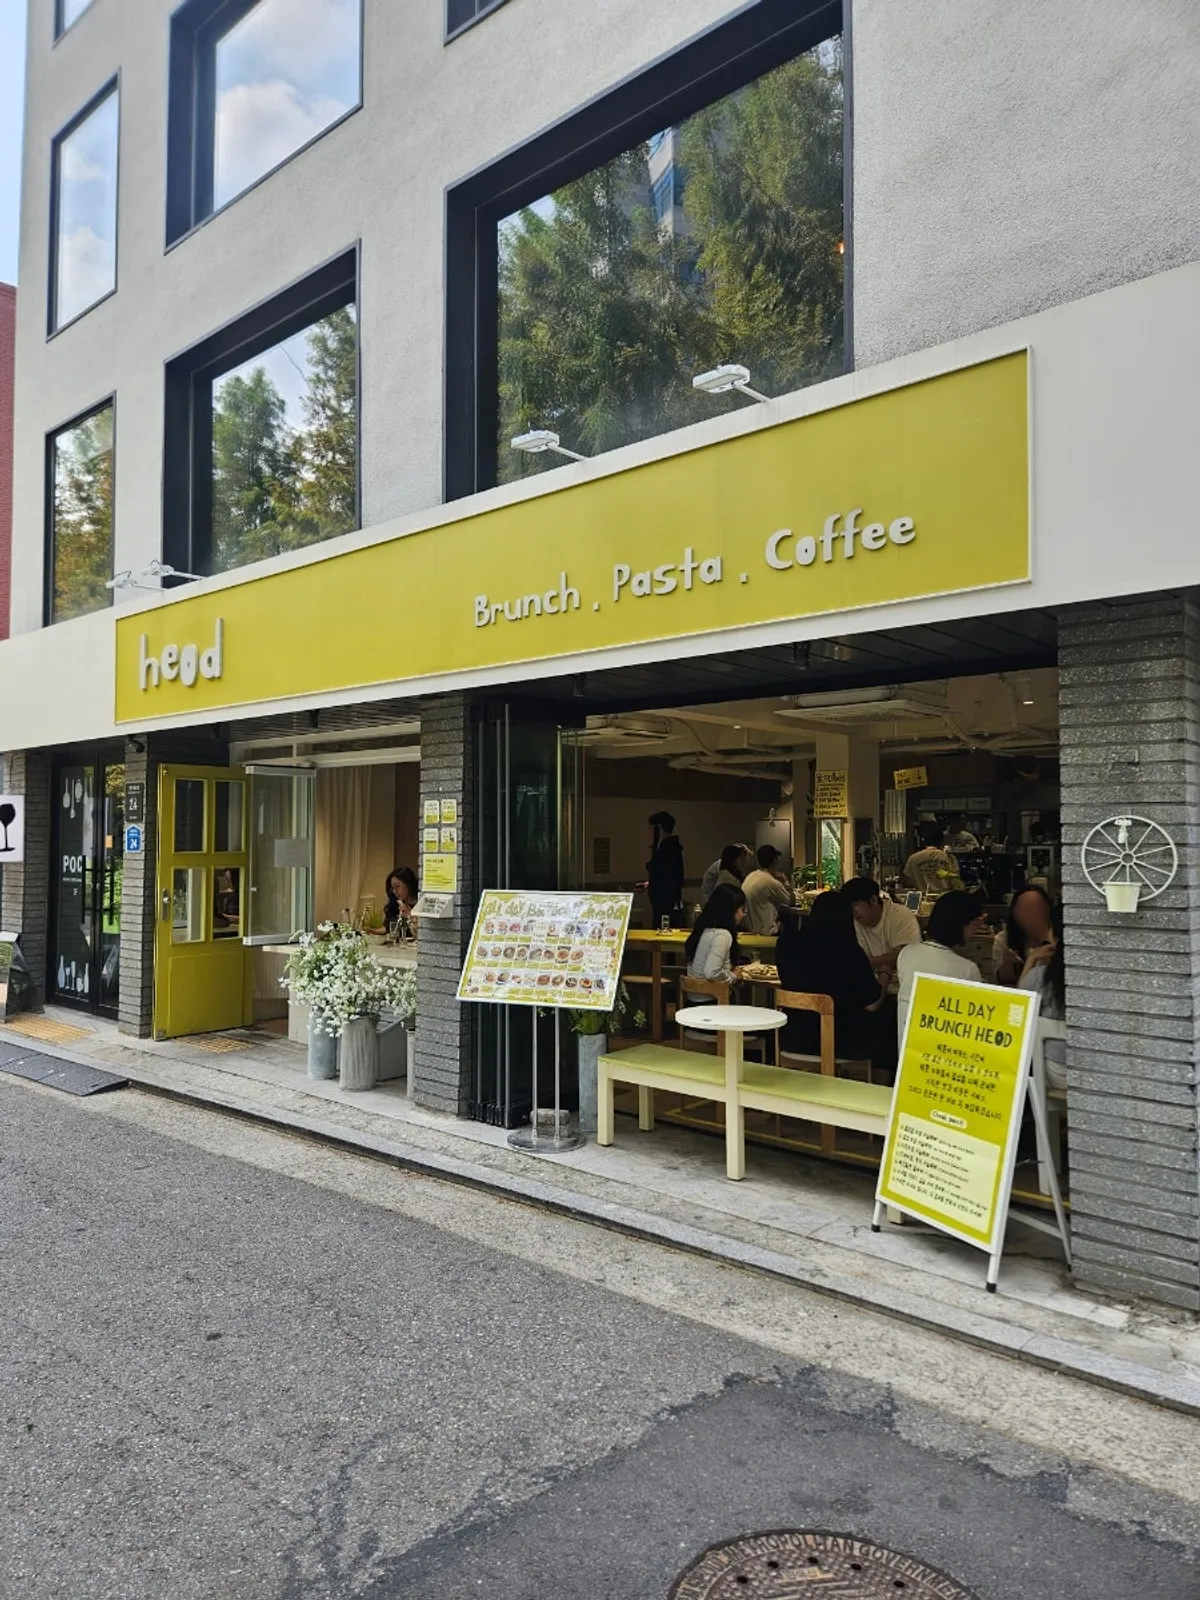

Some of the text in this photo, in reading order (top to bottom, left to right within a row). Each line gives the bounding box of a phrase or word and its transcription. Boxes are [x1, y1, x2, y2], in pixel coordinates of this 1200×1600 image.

[474, 571, 581, 628] Brunch
[613, 546, 723, 603] Pasta
[765, 507, 918, 571] Coffee
[937, 996, 996, 1022] ALL DAY
[919, 1013, 973, 1040] BRUNCH
